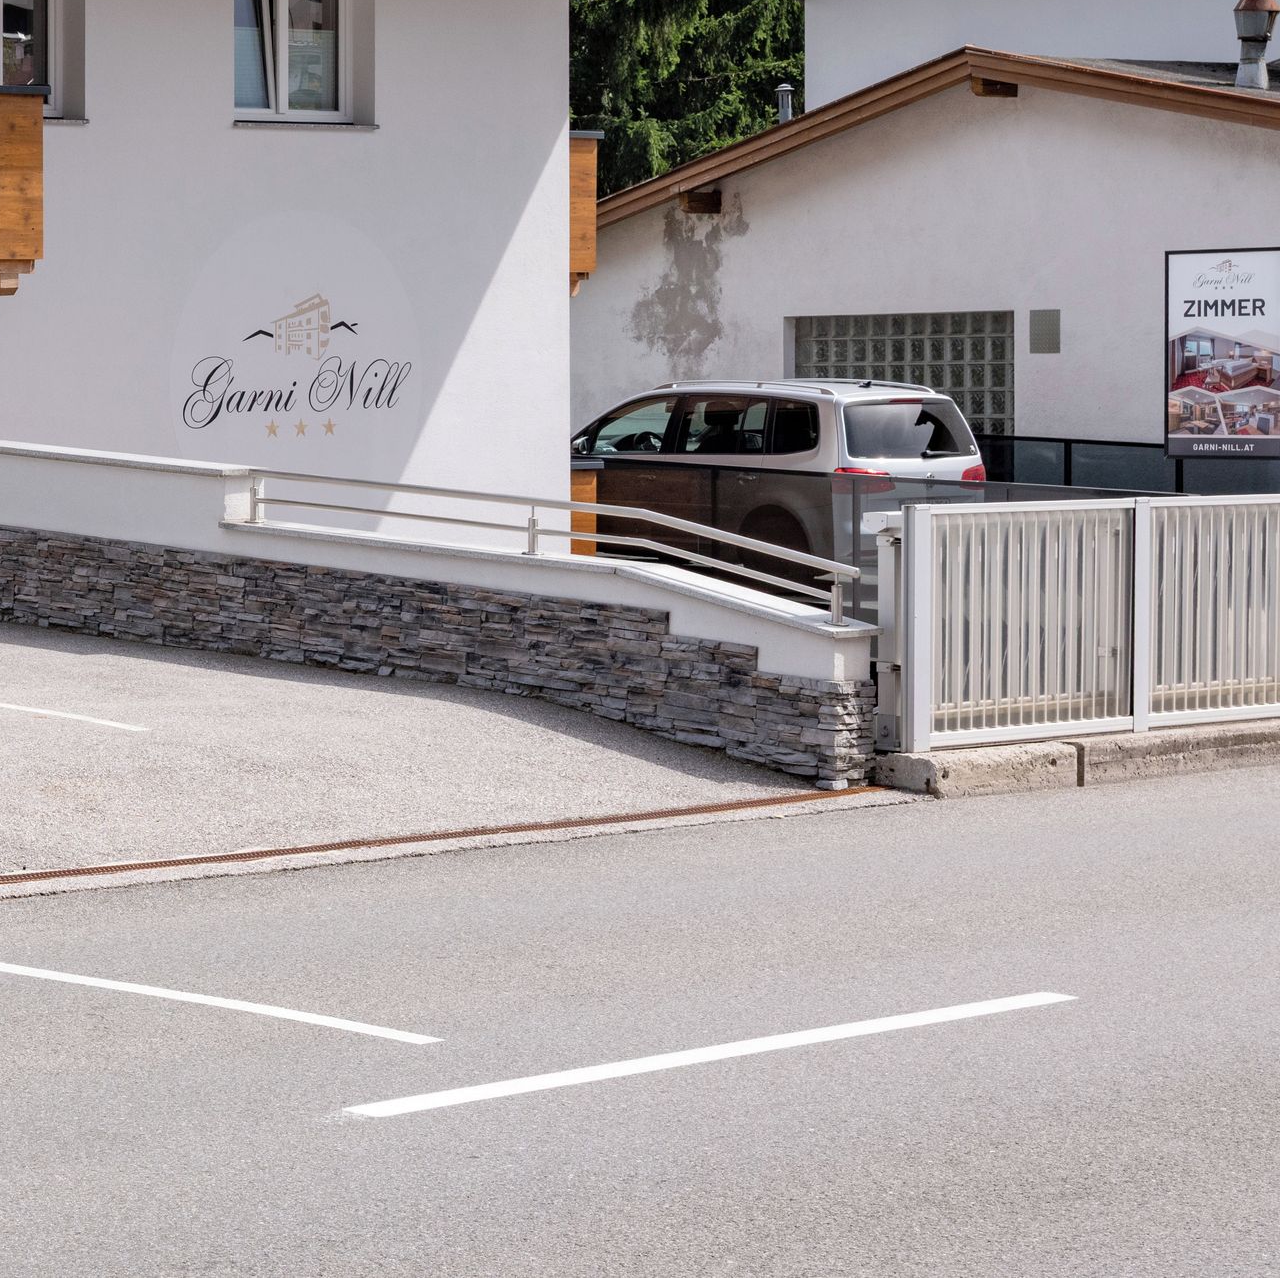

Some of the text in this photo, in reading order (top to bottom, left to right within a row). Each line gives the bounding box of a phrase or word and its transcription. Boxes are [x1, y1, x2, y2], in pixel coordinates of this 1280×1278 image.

[1193, 272, 1256, 289] Garni Nill
[1183, 298, 1266, 317] ZIMMER
[182, 356, 412, 429] Garni Nill
[1192, 443, 1255, 452] GARNI-NILL.AT
